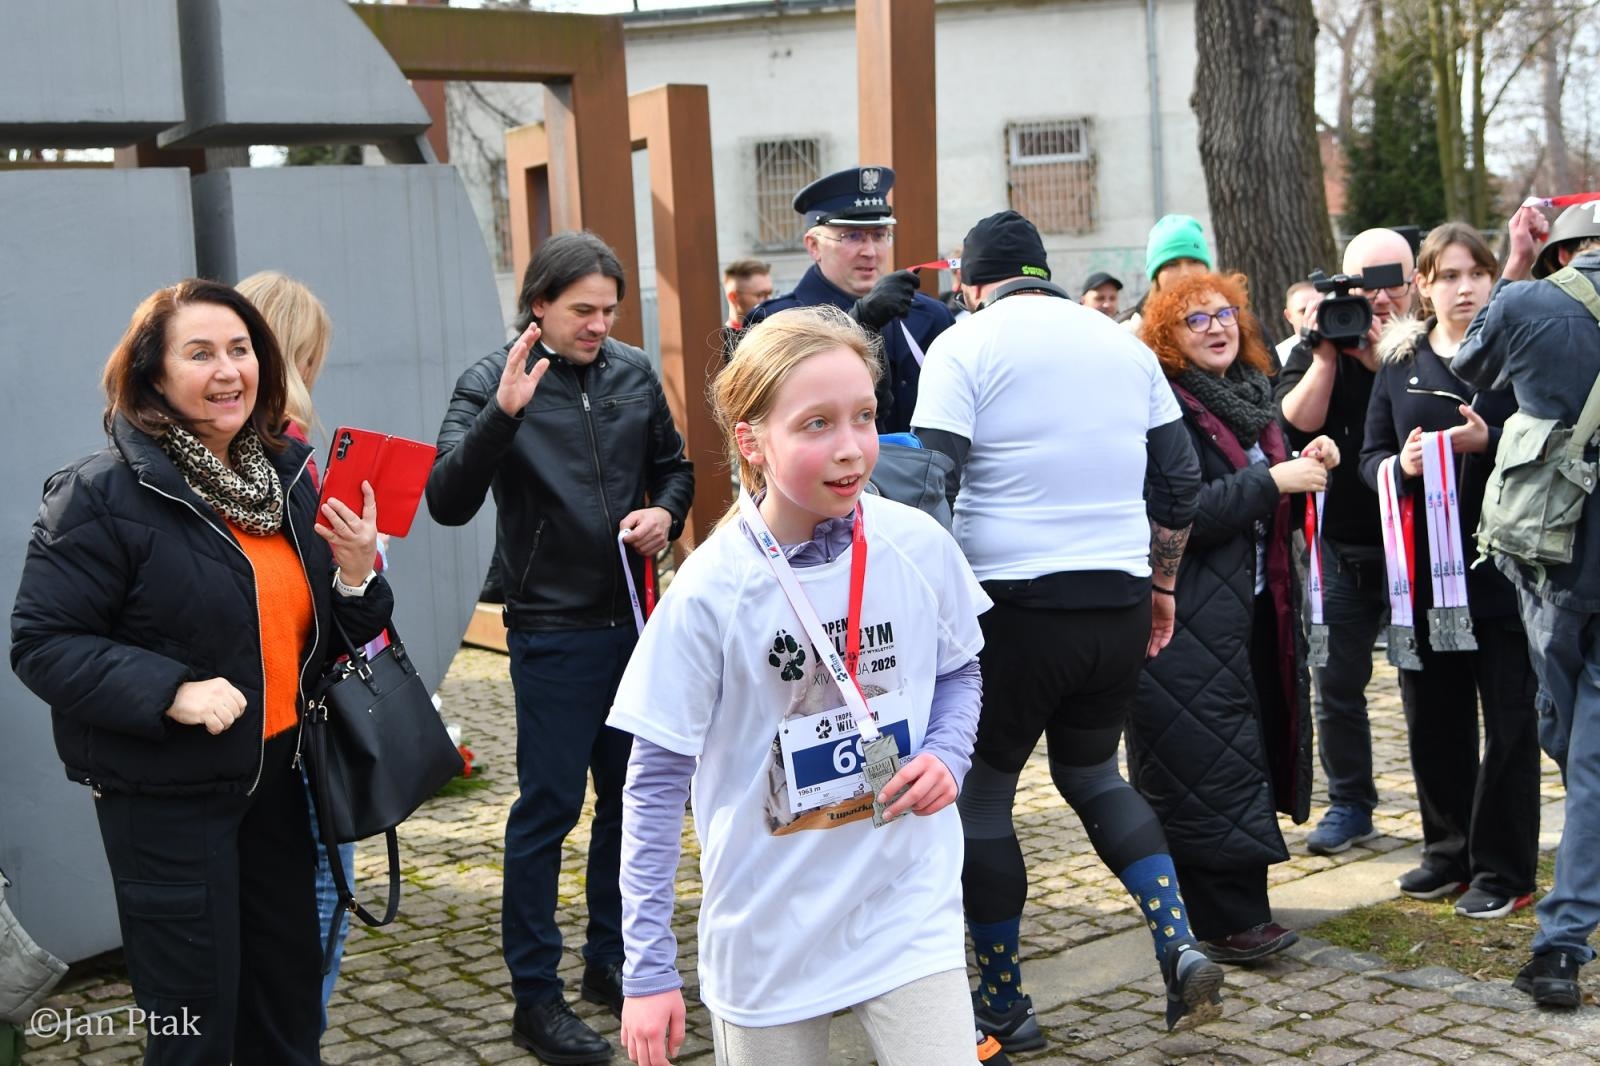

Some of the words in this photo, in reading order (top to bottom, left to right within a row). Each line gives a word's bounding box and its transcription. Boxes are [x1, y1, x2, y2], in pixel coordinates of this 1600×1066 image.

[871, 655, 896, 674] 2026
[834, 711, 853, 722] TROPE
[797, 788, 814, 797] 1963
